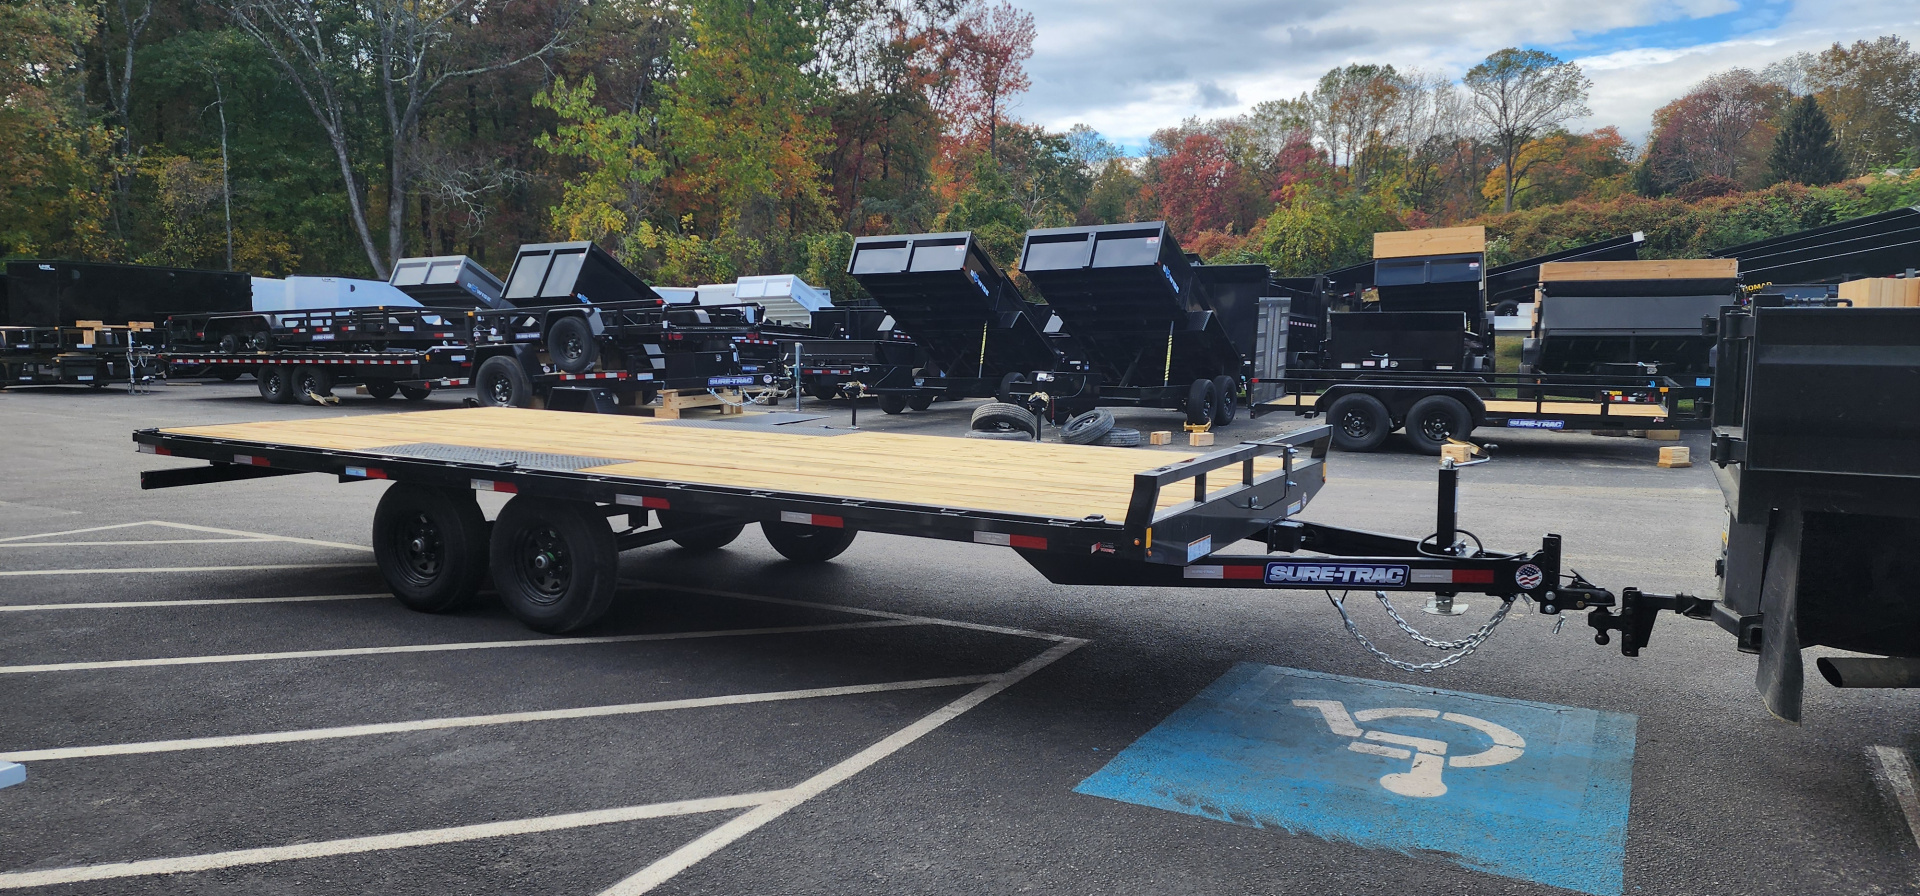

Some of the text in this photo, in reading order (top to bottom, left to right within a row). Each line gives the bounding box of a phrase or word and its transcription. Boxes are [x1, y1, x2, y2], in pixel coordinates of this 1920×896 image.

[709, 376, 753, 385] SURE-TRAC
[1509, 420, 1563, 428] SURE-TRAC
[1269, 566, 1404, 583] SURE-TRAC
